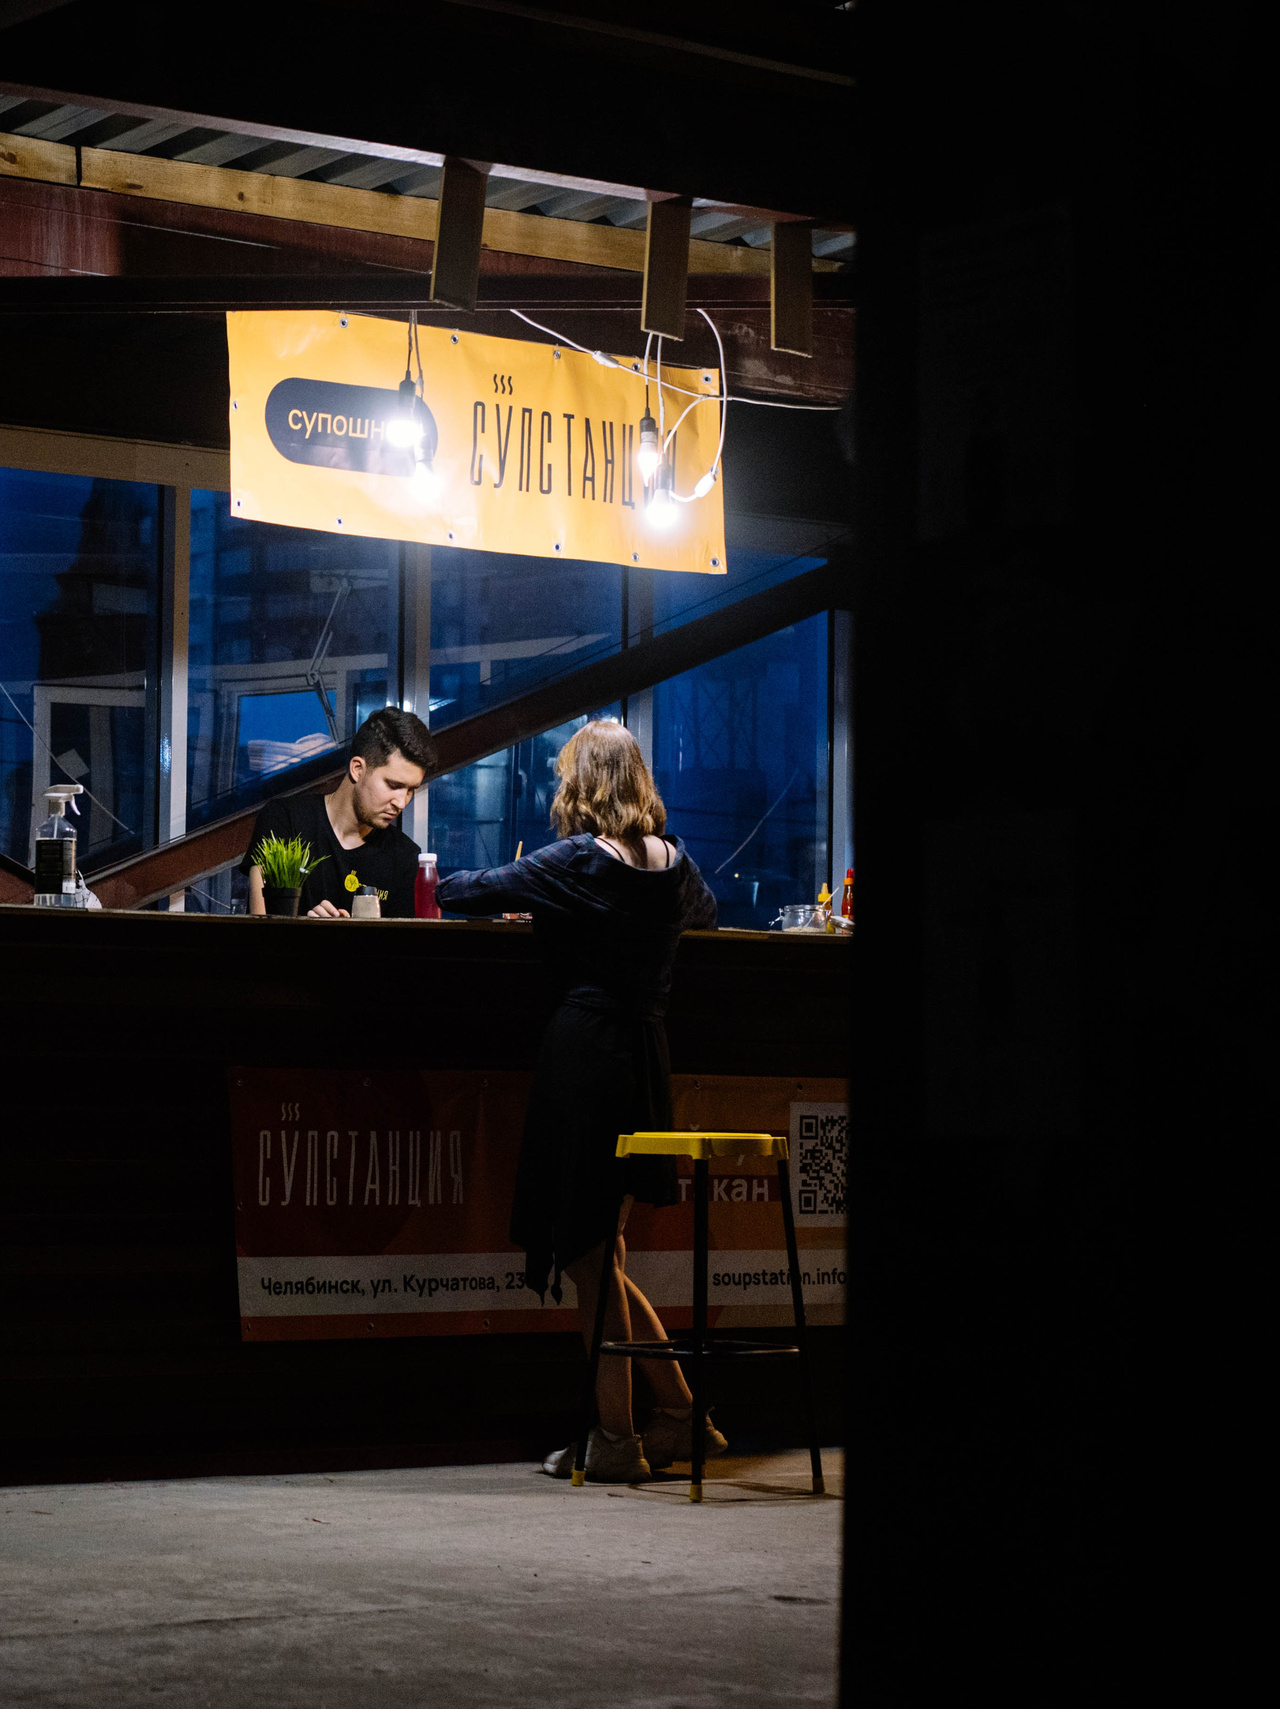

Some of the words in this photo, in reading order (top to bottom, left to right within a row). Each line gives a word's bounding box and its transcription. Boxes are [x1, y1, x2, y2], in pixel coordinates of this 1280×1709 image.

[287, 408, 402, 440] супошн
[258, 1129, 464, 1208] СУПСТАНЦИЯ
[261, 1276, 366, 1297] Челябинск,
[370, 1278, 398, 1298] ул.
[403, 1274, 501, 1298] Курчатова,
[712, 1267, 848, 1291] soupstatin.info
